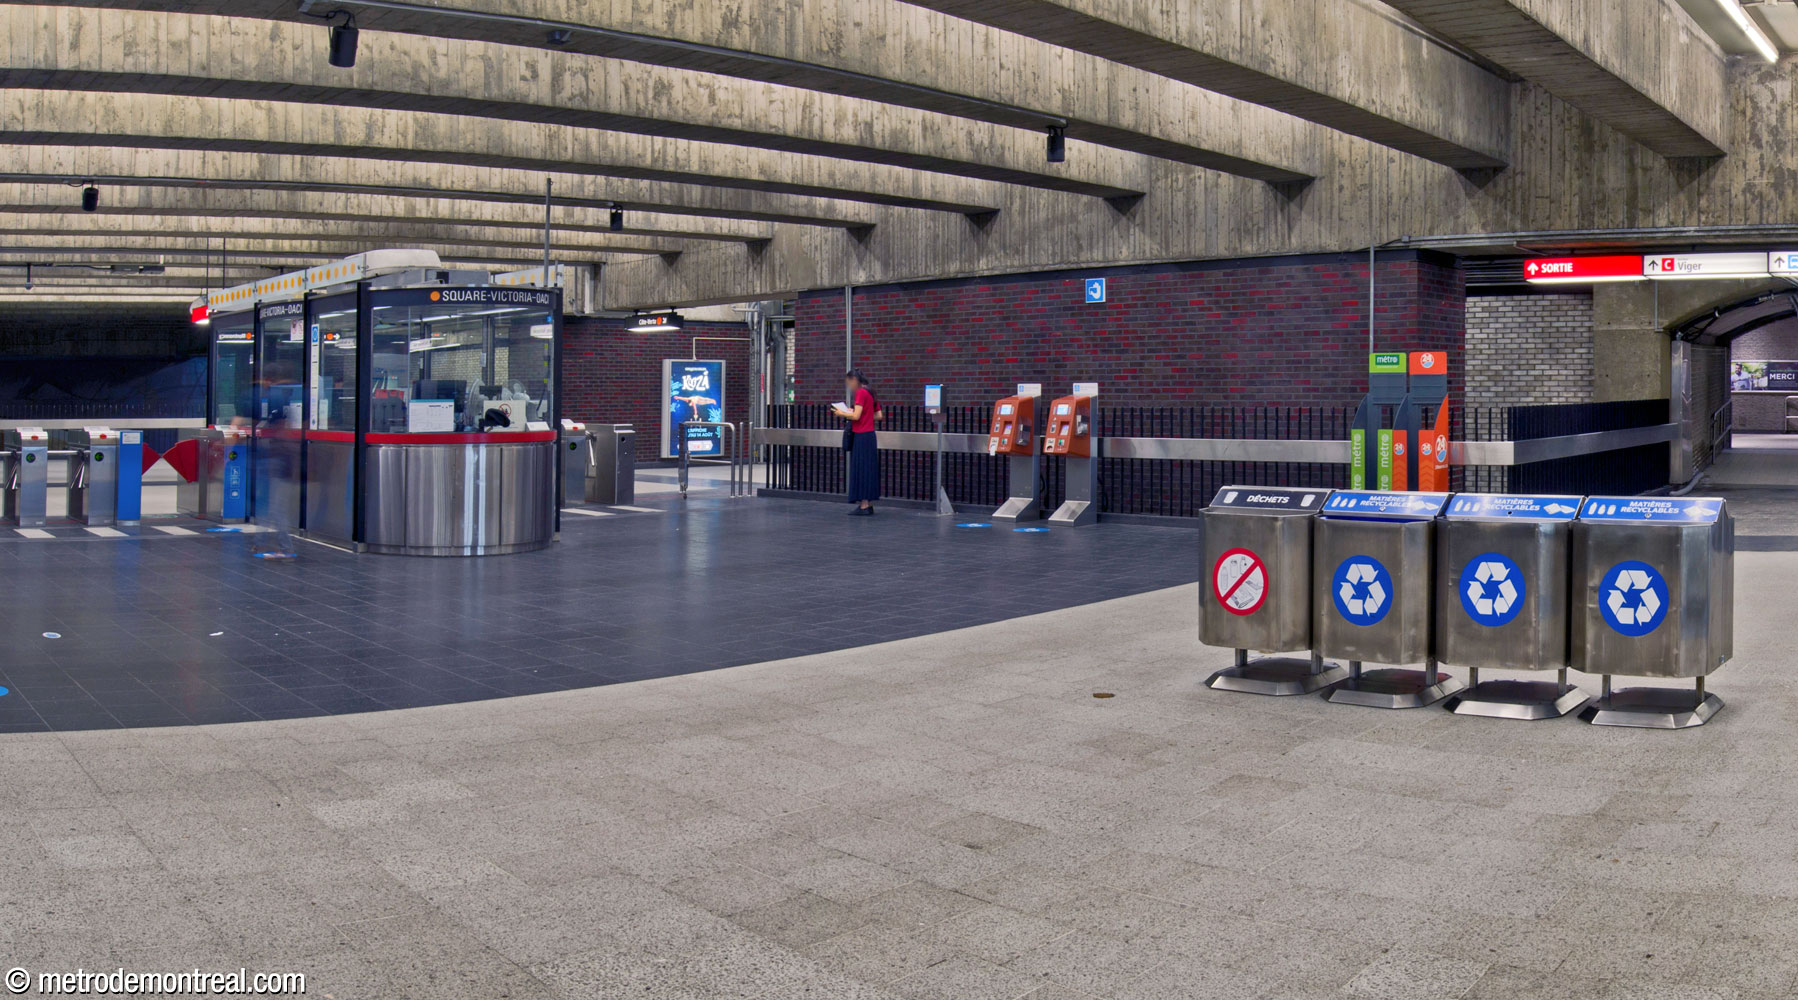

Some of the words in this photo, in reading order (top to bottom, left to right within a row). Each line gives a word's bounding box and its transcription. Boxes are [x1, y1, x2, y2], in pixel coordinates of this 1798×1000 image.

[1540, 262, 1574, 273] SORTIE
[1664, 260, 1672, 270] C
[1677, 261, 1702, 273] Viger
[1376, 355, 1398, 364] métro
[1769, 373, 1796, 381] MERCI
[1353, 433, 1361, 467] métro
[1381, 433, 1389, 468] métro
[1247, 494, 1290, 504] DÉCHETS
[1629, 500, 1673, 508] MATIÈRES
